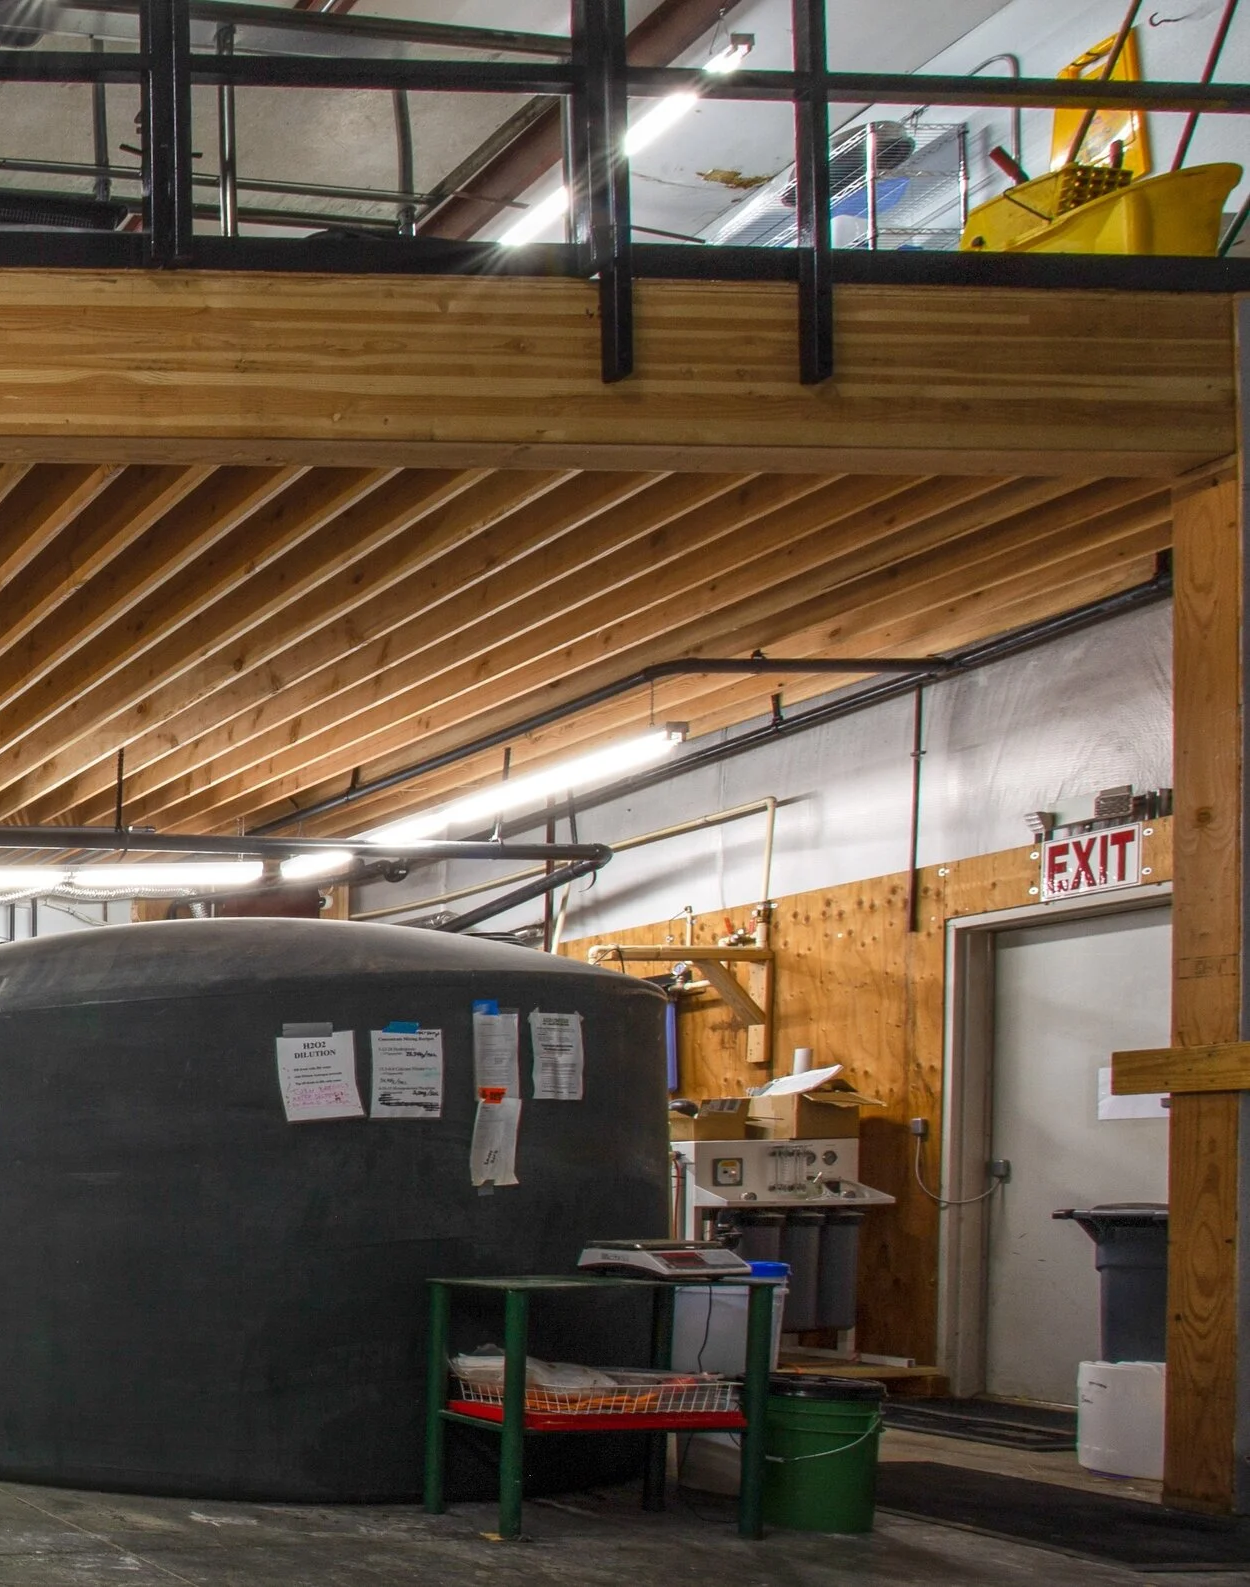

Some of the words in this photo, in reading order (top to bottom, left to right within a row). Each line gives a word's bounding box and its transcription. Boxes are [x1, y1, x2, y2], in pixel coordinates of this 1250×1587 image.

[1047, 829, 1135, 893] EXIT
[303, 1041, 326, 1049] H2O2
[294, 1049, 336, 1059] DILUTION
